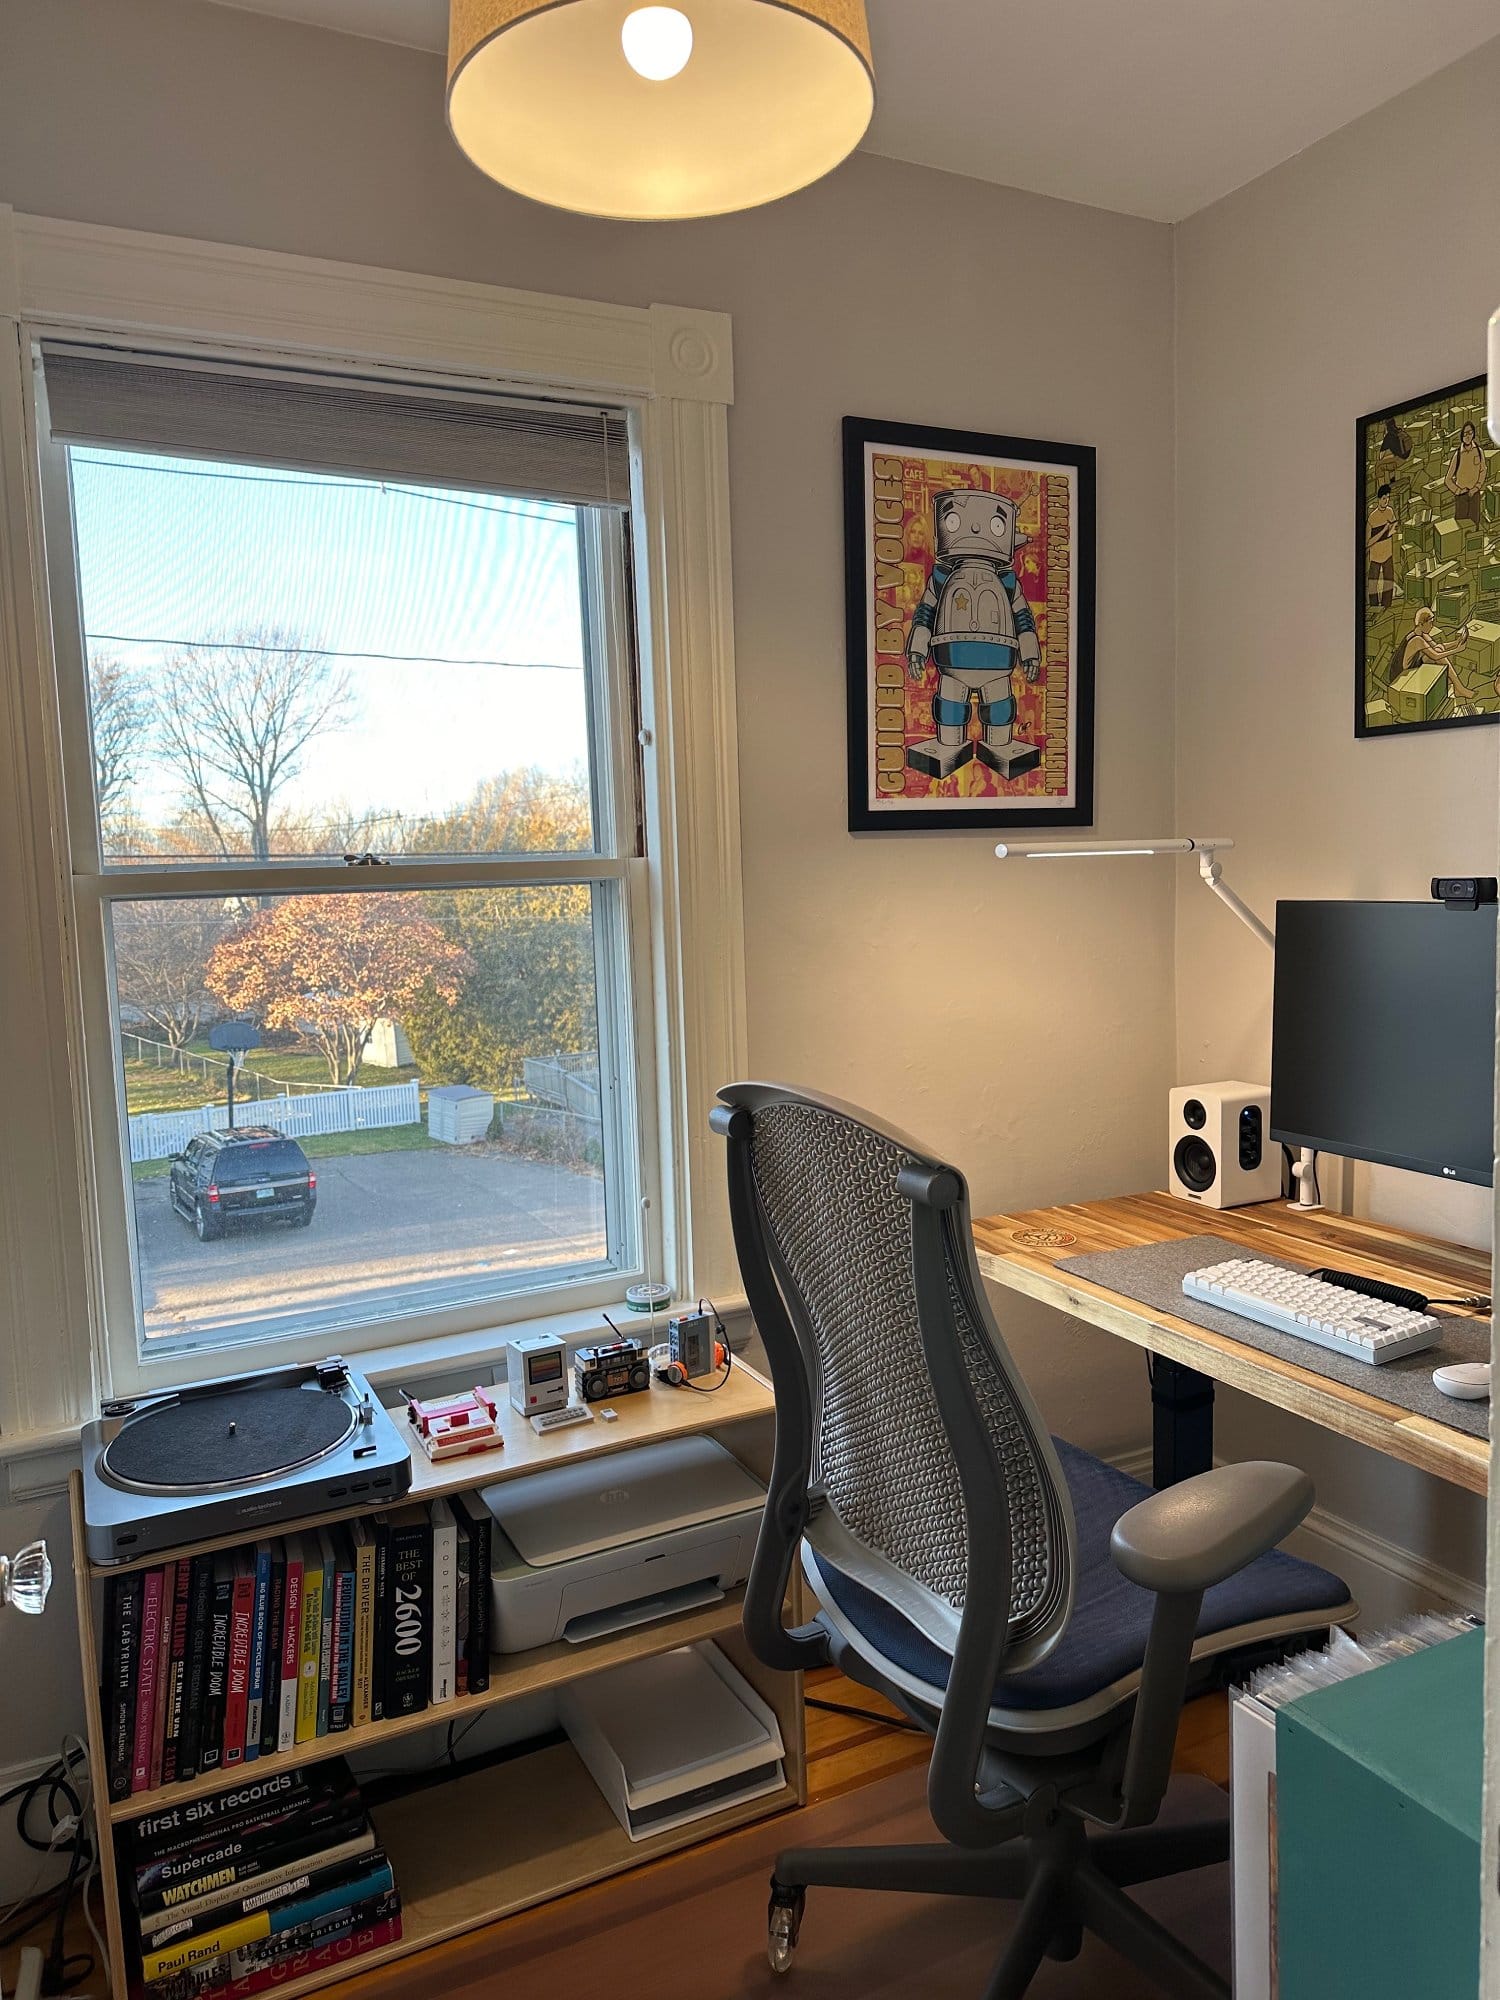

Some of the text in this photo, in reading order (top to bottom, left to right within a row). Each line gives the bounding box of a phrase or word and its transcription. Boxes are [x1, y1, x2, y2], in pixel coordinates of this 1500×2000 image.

[904, 468, 924, 480] CAFE
[874, 457, 904, 590] VOICES
[875, 599, 905, 655] BY
[1046, 610, 1068, 663] ANNEX
[876, 663, 905, 794] GUIDED
[1045, 665, 1068, 769] INDIANAPOLIS
[362, 1555, 370, 1573] THE
[395, 1559, 423, 1571] BEST
[399, 1549, 421, 1560] THE
[198, 1572, 207, 1587] the
[288, 1576, 299, 1608] DESIGN
[401, 1571, 416, 1582] OF
[172, 1557, 190, 1657] HENRY ROLLINS
[360, 1577, 370, 1614] DRIVER
[143, 1597, 158, 1655] ELECTRIC
[256, 1631, 263, 1640] OF
[337, 1577, 352, 1698] REVOLUTION IN THE VALLEY
[394, 1584, 422, 1656] 2600
[119, 1594, 132, 1688] THE LABYRINTH
[210, 1613, 227, 1667] INCREDIBLE
[231, 1611, 249, 1693] INCREDIBLE DOOM
[254, 1640, 262, 1665] BICYCLE
[285, 1626, 296, 1664] HACKERS
[140, 1658, 153, 1696] STATE
[176, 1660, 184, 1680] GET
[209, 1671, 223, 1696] DOOM
[320, 1649, 330, 1681] PERSPECTIVE
[175, 1682, 182, 1694] IN
[118, 1702, 126, 1724] SIMON
[141, 1700, 149, 1722] SIMON
[172, 1717, 180, 1738] VAN
[138, 1776, 292, 1838] first six records
[153, 1798, 310, 1856] THE MACROPHENOMENAL PRO BASKETBALL ALMANAC
[161, 1843, 242, 1879] Supercade
[161, 1866, 235, 1906] WATCHMEN
[166, 1911, 179, 1921] The
[181, 1902, 202, 1915] Visual
[204, 1893, 231, 1908] Display
[232, 1887, 240, 1896] of
[283, 1858, 323, 1876] Information
[260, 1943, 288, 1958] GLEN
[310, 1913, 364, 1939] FRIEDMAN
[159, 1941, 219, 1972] Paul Rand
